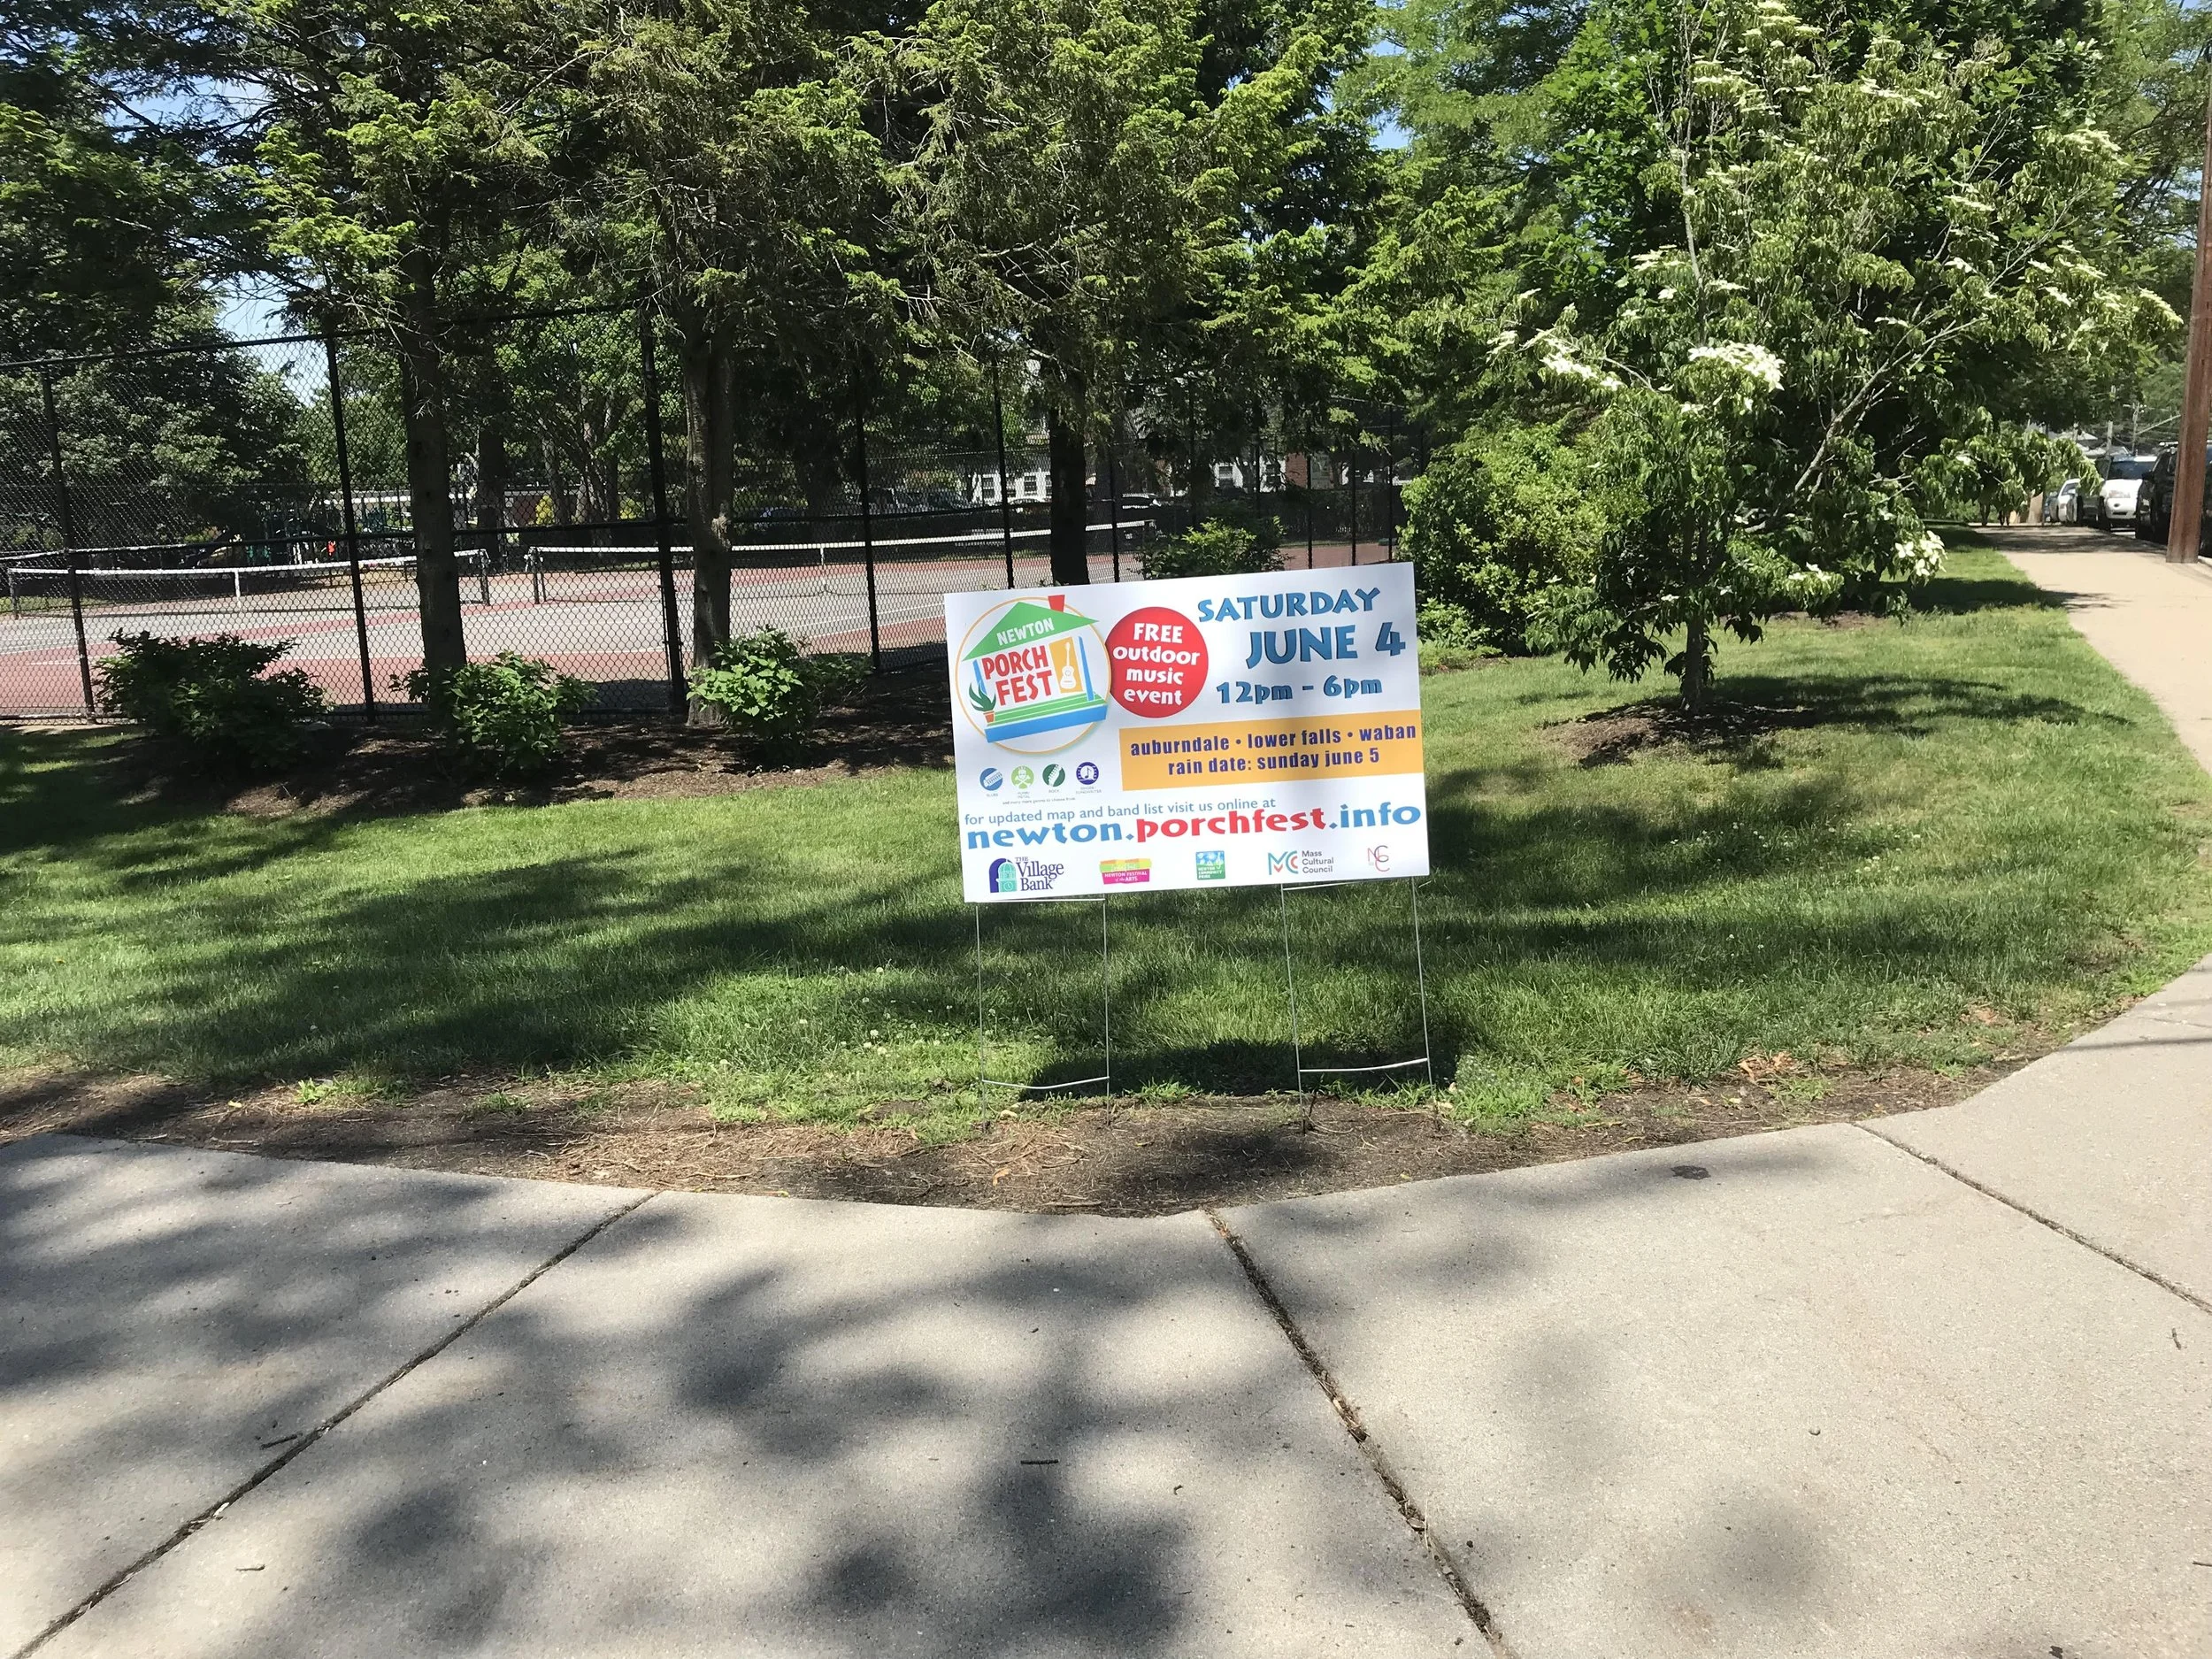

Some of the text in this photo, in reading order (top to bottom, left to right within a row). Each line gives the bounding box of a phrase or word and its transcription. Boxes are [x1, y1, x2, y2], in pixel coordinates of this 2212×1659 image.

[1197, 587, 1381, 623] SATURDAY
[996, 618, 1055, 646] NEWTON
[1133, 622, 1184, 644] FREE
[1245, 621, 1407, 670] JUNE 4
[981, 645, 1049, 680] PORCH
[1112, 646, 1201, 665] outdoor
[995, 670, 1053, 706] FEST
[1125, 667, 1184, 686] music
[1216, 681, 1294, 705] 12pm
[1323, 674, 1383, 699] 6pm
[1124, 687, 1183, 706] event
[1130, 725, 1417, 757] auburndale lower falls waban
[1168, 747, 1380, 775] rain date: sunday june 5
[964, 798, 1276, 826] for updated map and band list visit us online at
[967, 802, 1421, 849] newton.porchfest.info
[1016, 861, 1064, 880] Village
[1302, 856, 1334, 865] Cultural
[1020, 876, 1054, 891] Bank
